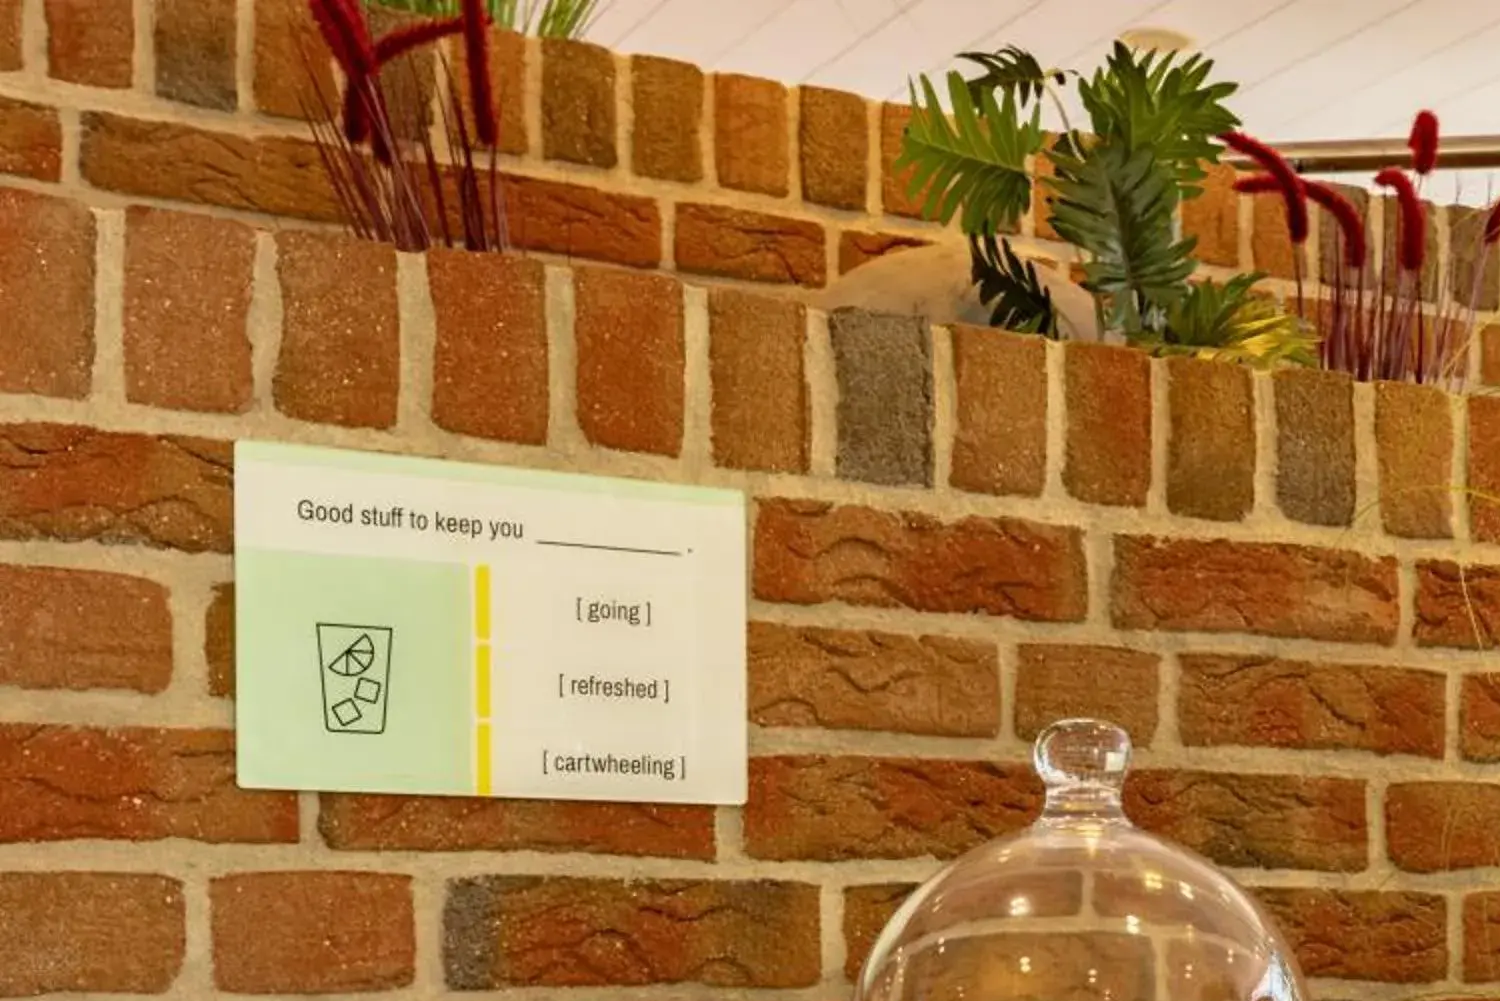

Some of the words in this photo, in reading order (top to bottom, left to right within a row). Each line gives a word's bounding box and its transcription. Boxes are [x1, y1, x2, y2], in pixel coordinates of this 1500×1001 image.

[297, 499, 353, 524] Good
[360, 507, 403, 528] stuff
[409, 511, 429, 531] to
[435, 511, 483, 539] keep
[489, 521, 524, 541] you
